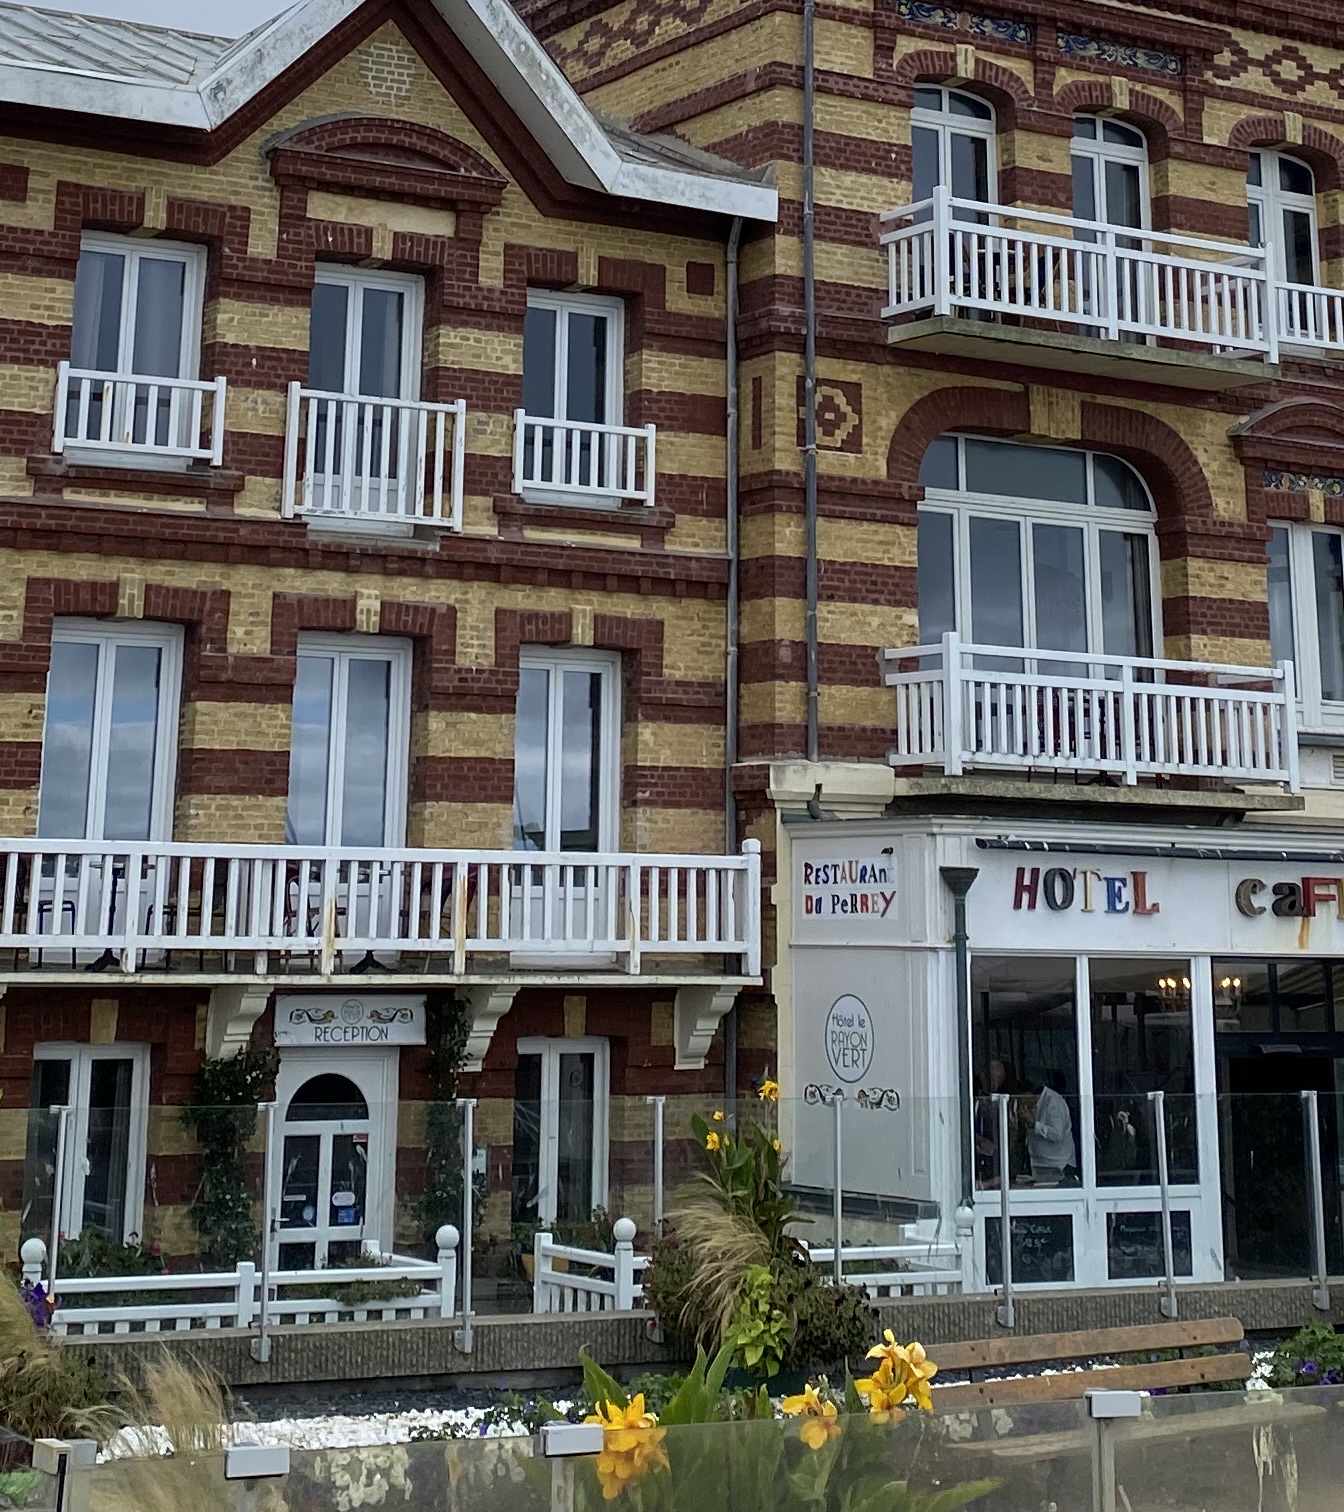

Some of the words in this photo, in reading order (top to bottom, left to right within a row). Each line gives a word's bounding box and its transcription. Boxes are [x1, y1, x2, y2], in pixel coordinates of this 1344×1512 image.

[1013, 866, 1160, 915] HOTEL
[314, 1026, 389, 1042] RECEPTION
[831, 1031, 868, 1048] RAYON
[831, 1048, 868, 1069] VERT
